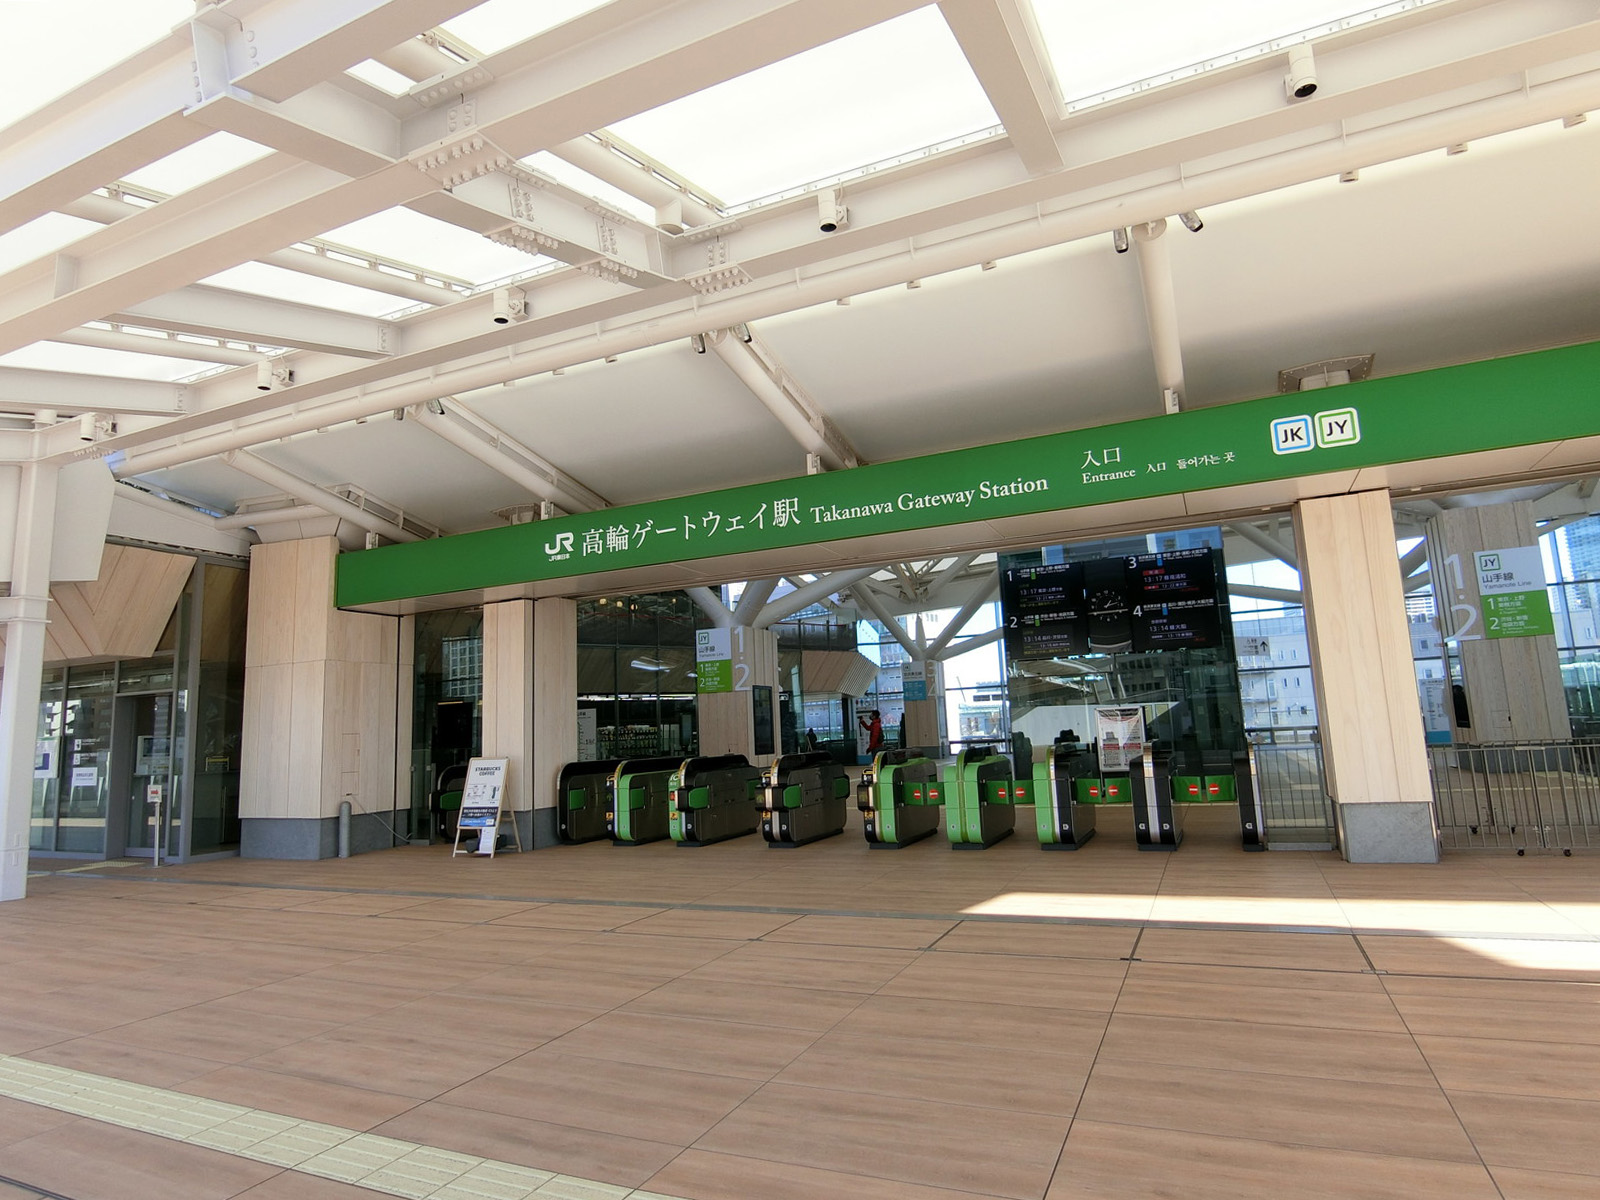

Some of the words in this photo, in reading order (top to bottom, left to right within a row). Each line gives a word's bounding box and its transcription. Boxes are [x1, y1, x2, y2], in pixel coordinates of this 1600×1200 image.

[1281, 426, 1304, 443] JK
[1326, 419, 1348, 437] JY
[1081, 447, 1121, 470] 入口
[1177, 454, 1220, 470] 들어가는
[1146, 462, 1167, 473] 入口
[1082, 468, 1136, 484] Entrance
[810, 502, 894, 524] Takanawa
[897, 488, 976, 511] Gateway
[979, 477, 1049, 499] Station
[581, 497, 801, 557] 高輪ゲートウェイ駅
[545, 532, 574, 555] JR
[1128, 556, 1137, 569] 3
[1484, 558, 1496, 568] JY
[1007, 570, 1012, 581] 1
[1482, 572, 1515, 583] 山手線
[1484, 582, 1516, 590] Yamanote
[1487, 598, 1494, 610] 1
[1133, 605, 1142, 617] 4
[1010, 616, 1018, 628] 2
[1490, 617, 1500, 630] 2
